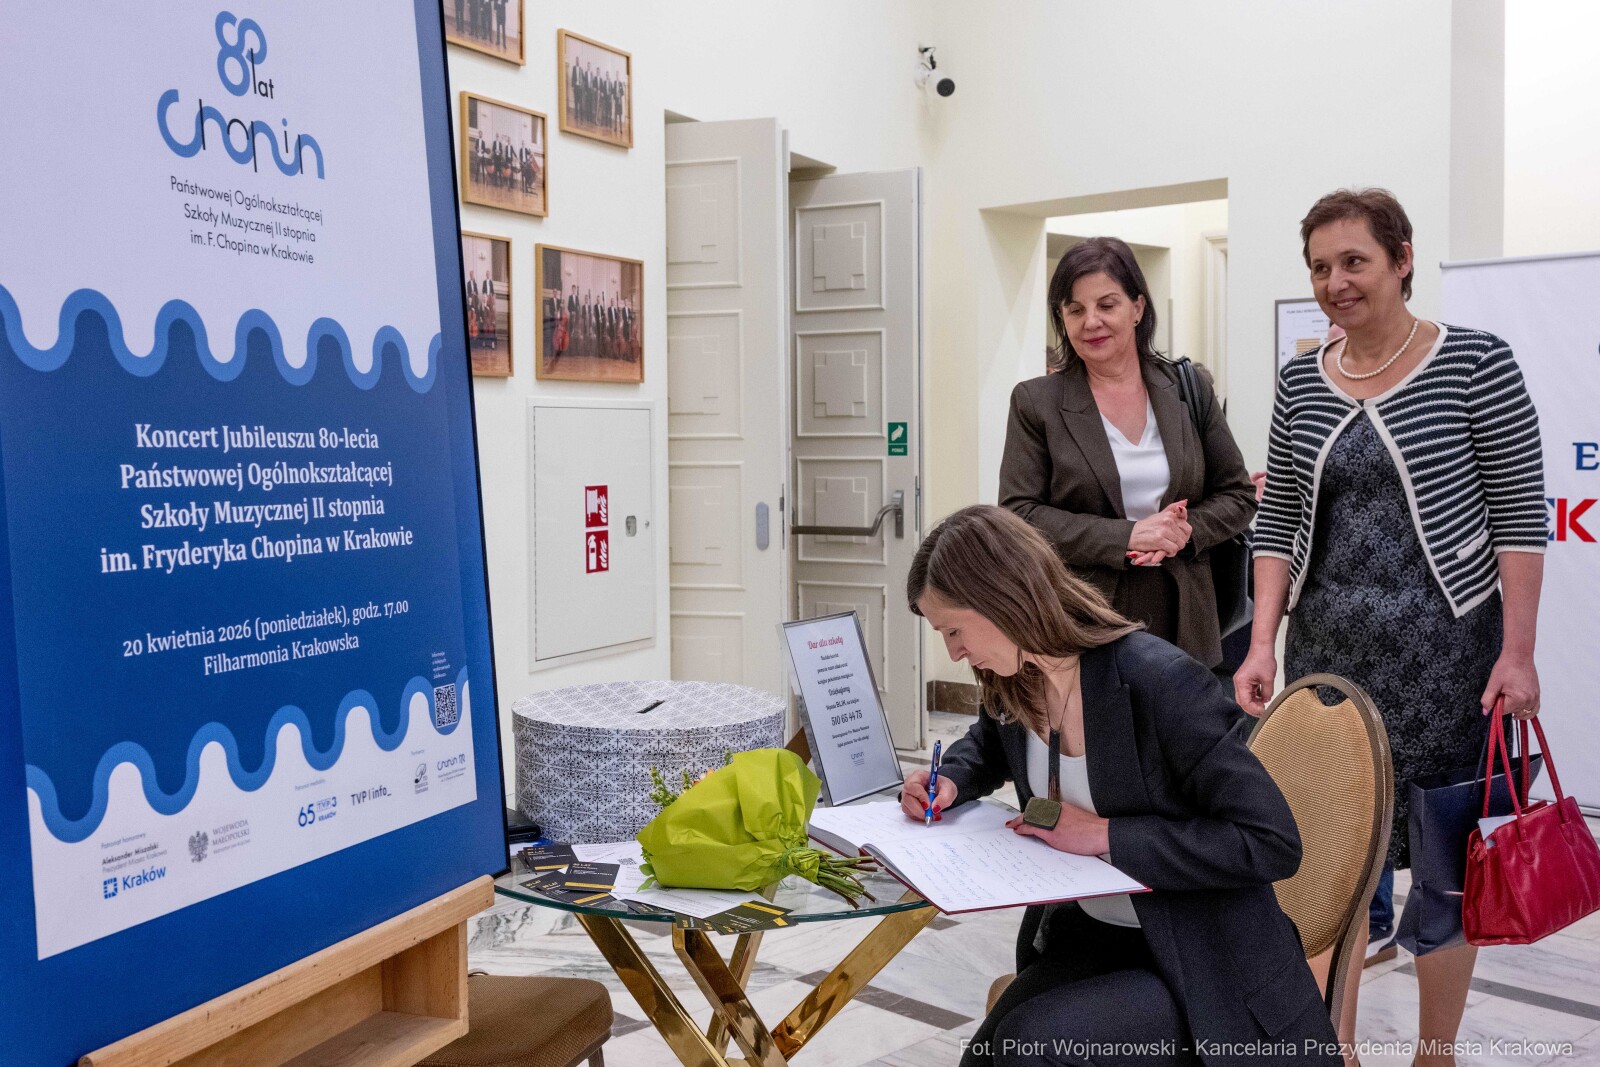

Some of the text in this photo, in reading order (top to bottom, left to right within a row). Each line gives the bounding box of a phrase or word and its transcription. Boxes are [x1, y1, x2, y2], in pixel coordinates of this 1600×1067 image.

[250, 48, 274, 99] lat
[157, 88, 325, 180] Chopin
[170, 175, 323, 225] Państwowej Ogólnokształcącej
[184, 203, 316, 243] Szkoły Muzycznej II stopnia
[190, 229, 314, 265] im. F. Chopina w Krakowie
[135, 423, 379, 453] Koncert Jubileuszu 80-lecia
[120, 461, 393, 491] Państwowej Ogólnokształcącej
[140, 495, 385, 532] Szkoły Muzycznej II stopnia
[100, 526, 414, 574] im. Fryderyka Chopina w Krakowie
[122, 600, 409, 658] 20 kwietnia 2026 (poniedziałek), godz. 17.00
[203, 633, 359, 675] Filharmonia Krakowska
[855, 709, 863, 719] 75
[351, 790, 367, 806] TVP
[213, 819, 249, 835] WOJEWODA
[298, 803, 316, 827] 65
[212, 828, 250, 846] MAŁOPOLSKI
[102, 851, 133, 865] Aleksander
[122, 865, 166, 891] Kraków
